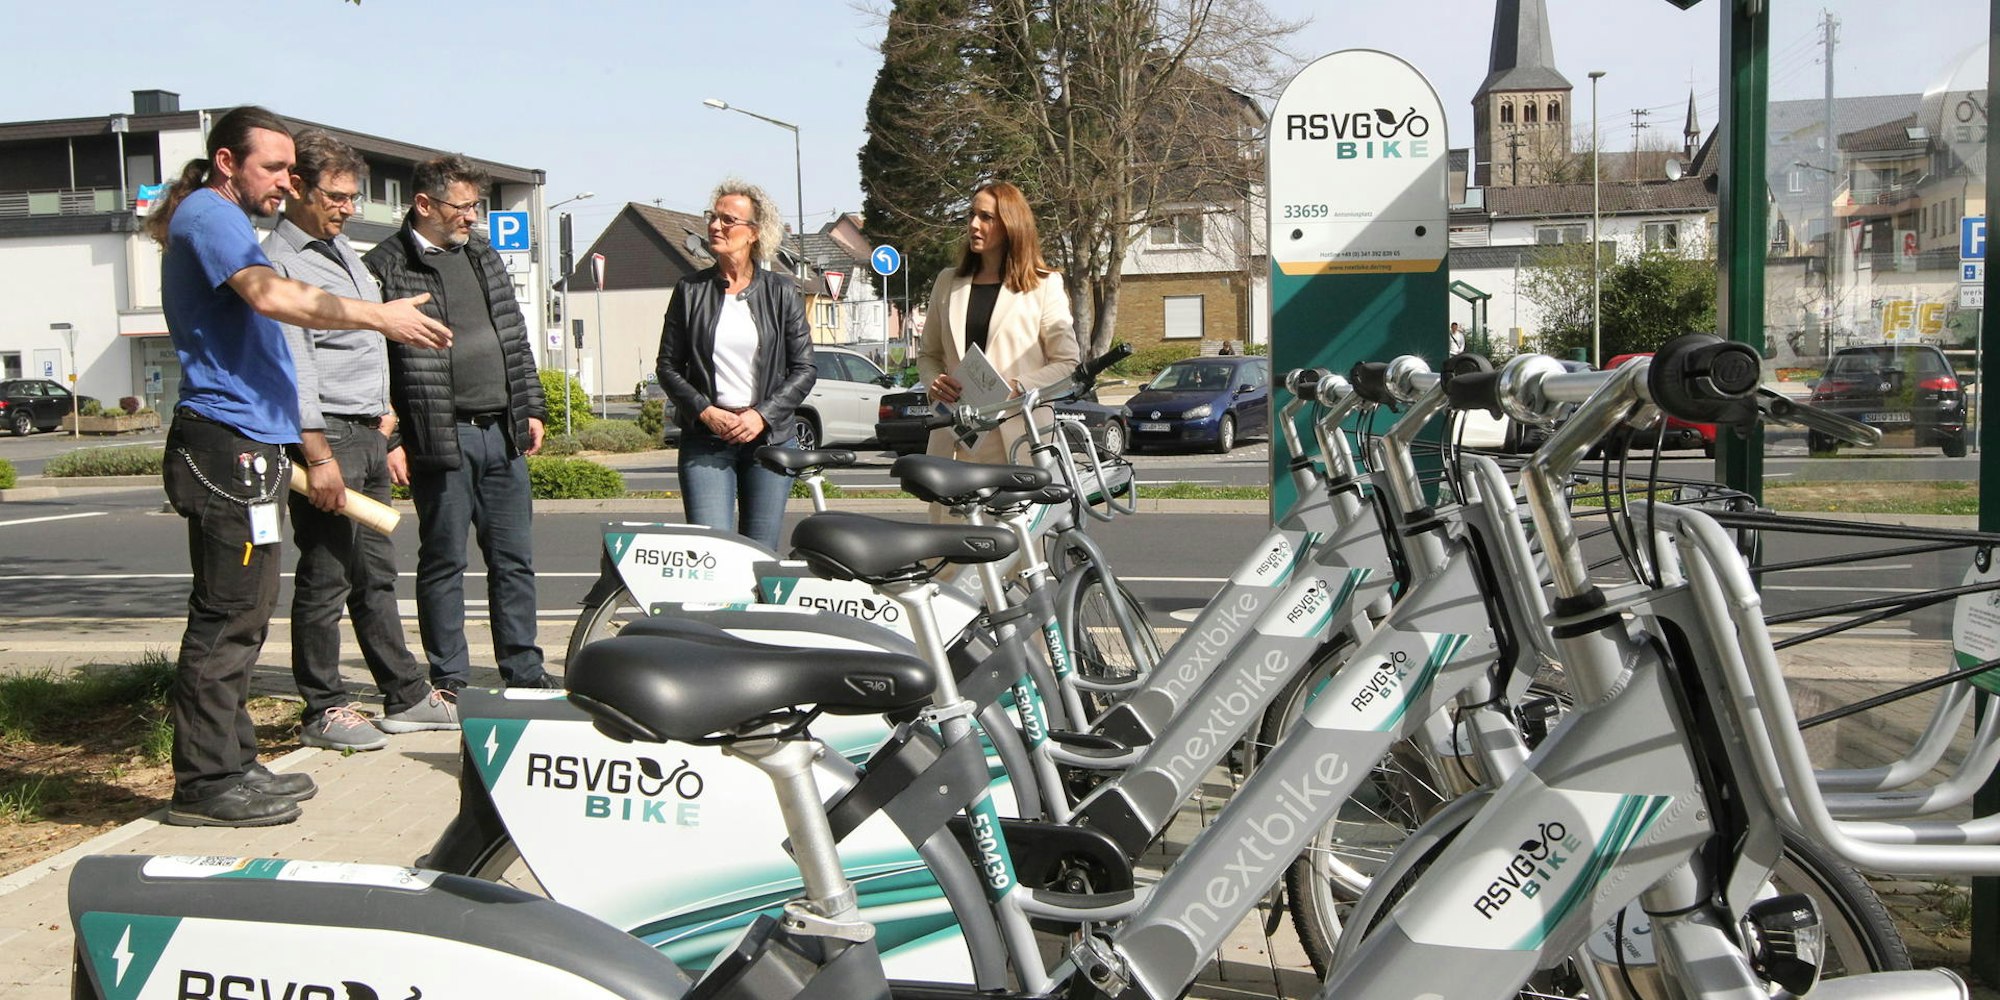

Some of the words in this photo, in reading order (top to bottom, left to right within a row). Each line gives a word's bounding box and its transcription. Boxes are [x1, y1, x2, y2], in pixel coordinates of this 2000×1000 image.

[1287, 112, 1372, 141] RSVG
[1336, 140, 1429, 160] BIKE
[1284, 204, 1329, 219] 33659
[497, 216, 520, 247] P
[1963, 288, 1983, 296] werk
[635, 548, 684, 568] RSVG
[661, 567, 715, 582] BIKE
[1256, 552, 1278, 576] RSVG
[1272, 552, 1288, 569] BIK
[1287, 594, 1314, 623] RSVG
[1307, 585, 1334, 614] BIKE
[1046, 629, 1067, 674] 530451
[1163, 592, 1259, 701] nextbike
[1351, 671, 1388, 712] RSVG
[1379, 657, 1417, 700] BIKE
[1013, 685, 1043, 743] 530422
[1165, 649, 1290, 783] nextbike
[526, 752, 633, 795] RSVG
[584, 794, 701, 827] BIKE
[970, 812, 1010, 891] 530439
[1179, 752, 1349, 938] nextbike
[1520, 833, 1582, 900] BIKE
[1473, 854, 1536, 920] RSVG
